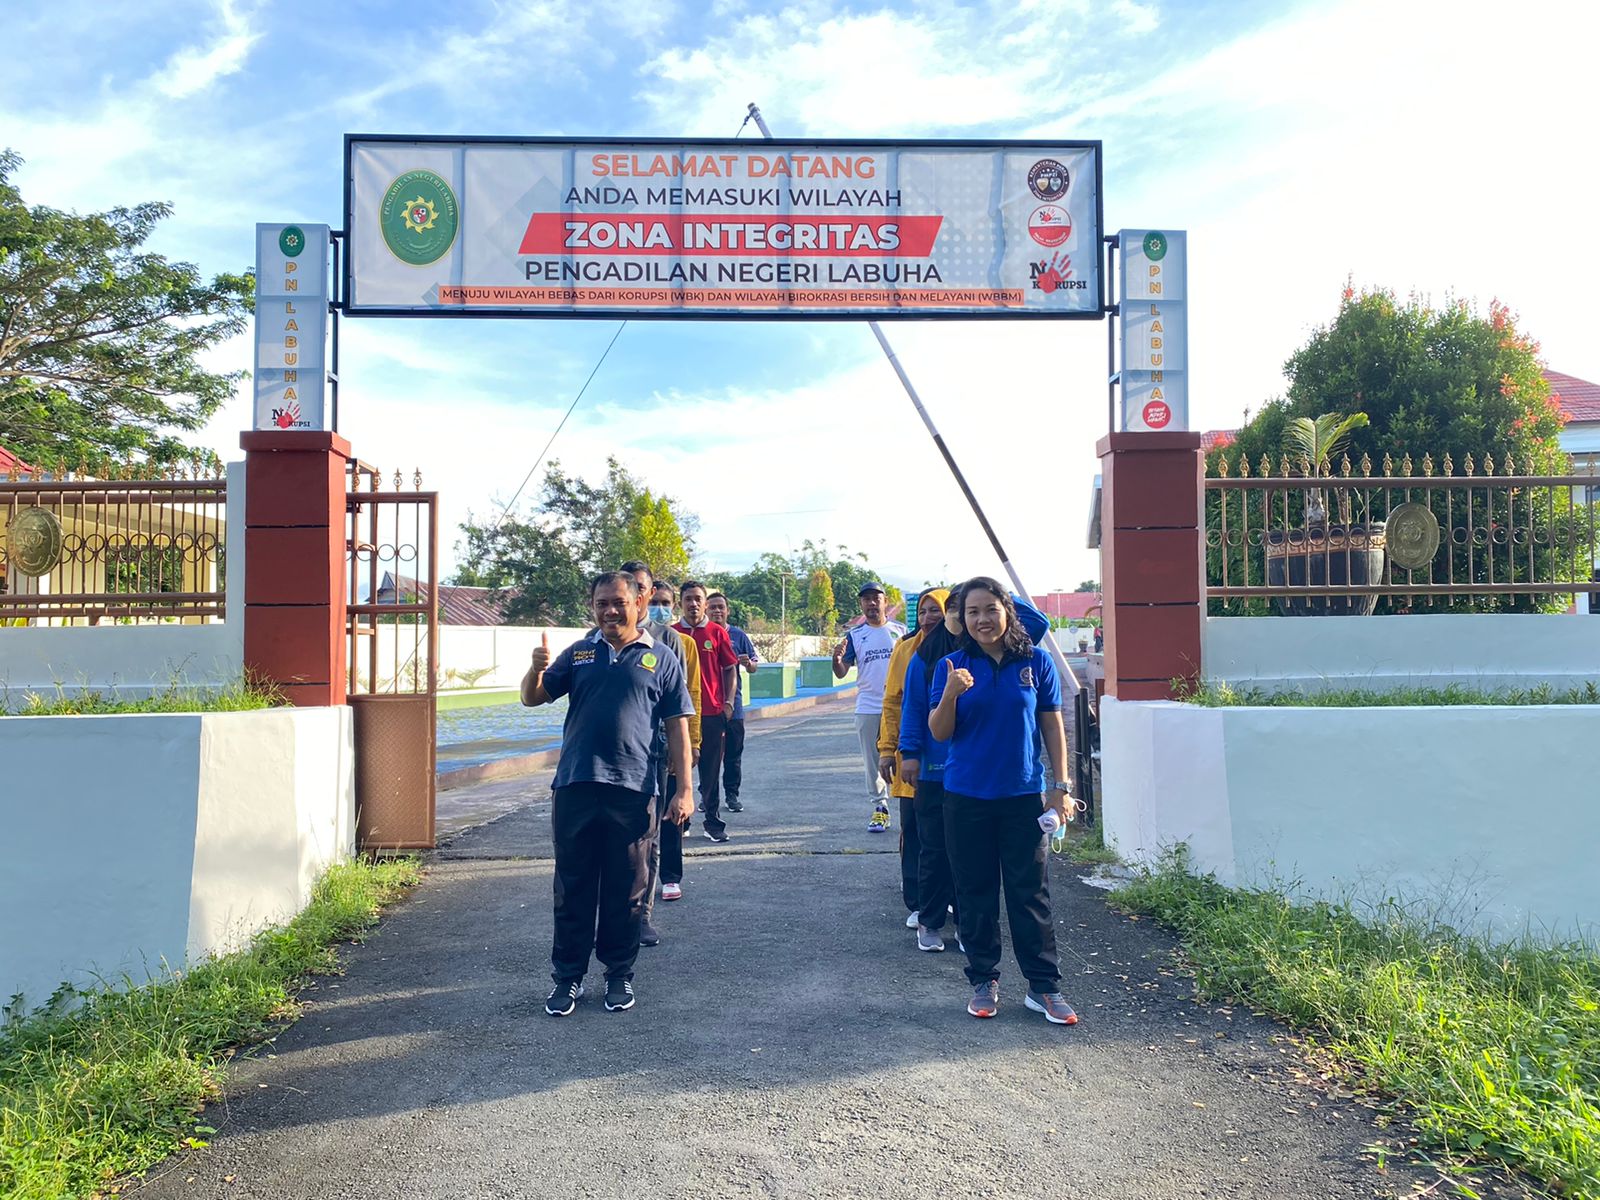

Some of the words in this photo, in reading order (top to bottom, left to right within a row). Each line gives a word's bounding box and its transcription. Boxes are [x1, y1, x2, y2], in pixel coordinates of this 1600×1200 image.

[591, 154, 738, 178] SELAMAT
[747, 155, 875, 179] DATANG
[564, 187, 639, 205] ANDA
[646, 188, 780, 206] MEMASUKI
[788, 189, 902, 207] WILAYAH
[564, 220, 674, 249] ZONA
[682, 222, 901, 250] INTEGRITAS
[525, 261, 708, 282] PENGADILAN
[718, 262, 818, 283] NEGERI
[828, 263, 943, 283] LABUHA
[442, 290, 490, 299] MENUJU
[494, 290, 545, 300] WILAYAH
[549, 290, 586, 300] BEBAS
[588, 291, 616, 300] DARI
[618, 292, 668, 300] KORUPSI
[670, 292, 705, 302] (WBK)
[707, 292, 732, 301] DAN
[735, 292, 785, 301] WILAYAH
[788, 292, 848, 301] BIROKRASI
[851, 292, 890, 301] BERSIH
[893, 292, 918, 301] DAN
[919, 292, 975, 301] MELAYANI
[978, 292, 1022, 303] (WBBM)
[1032, 280, 1087, 290] KRUPSI
[283, 301, 299, 400] LABUHA
[1150, 303, 1163, 400] LABUHA
